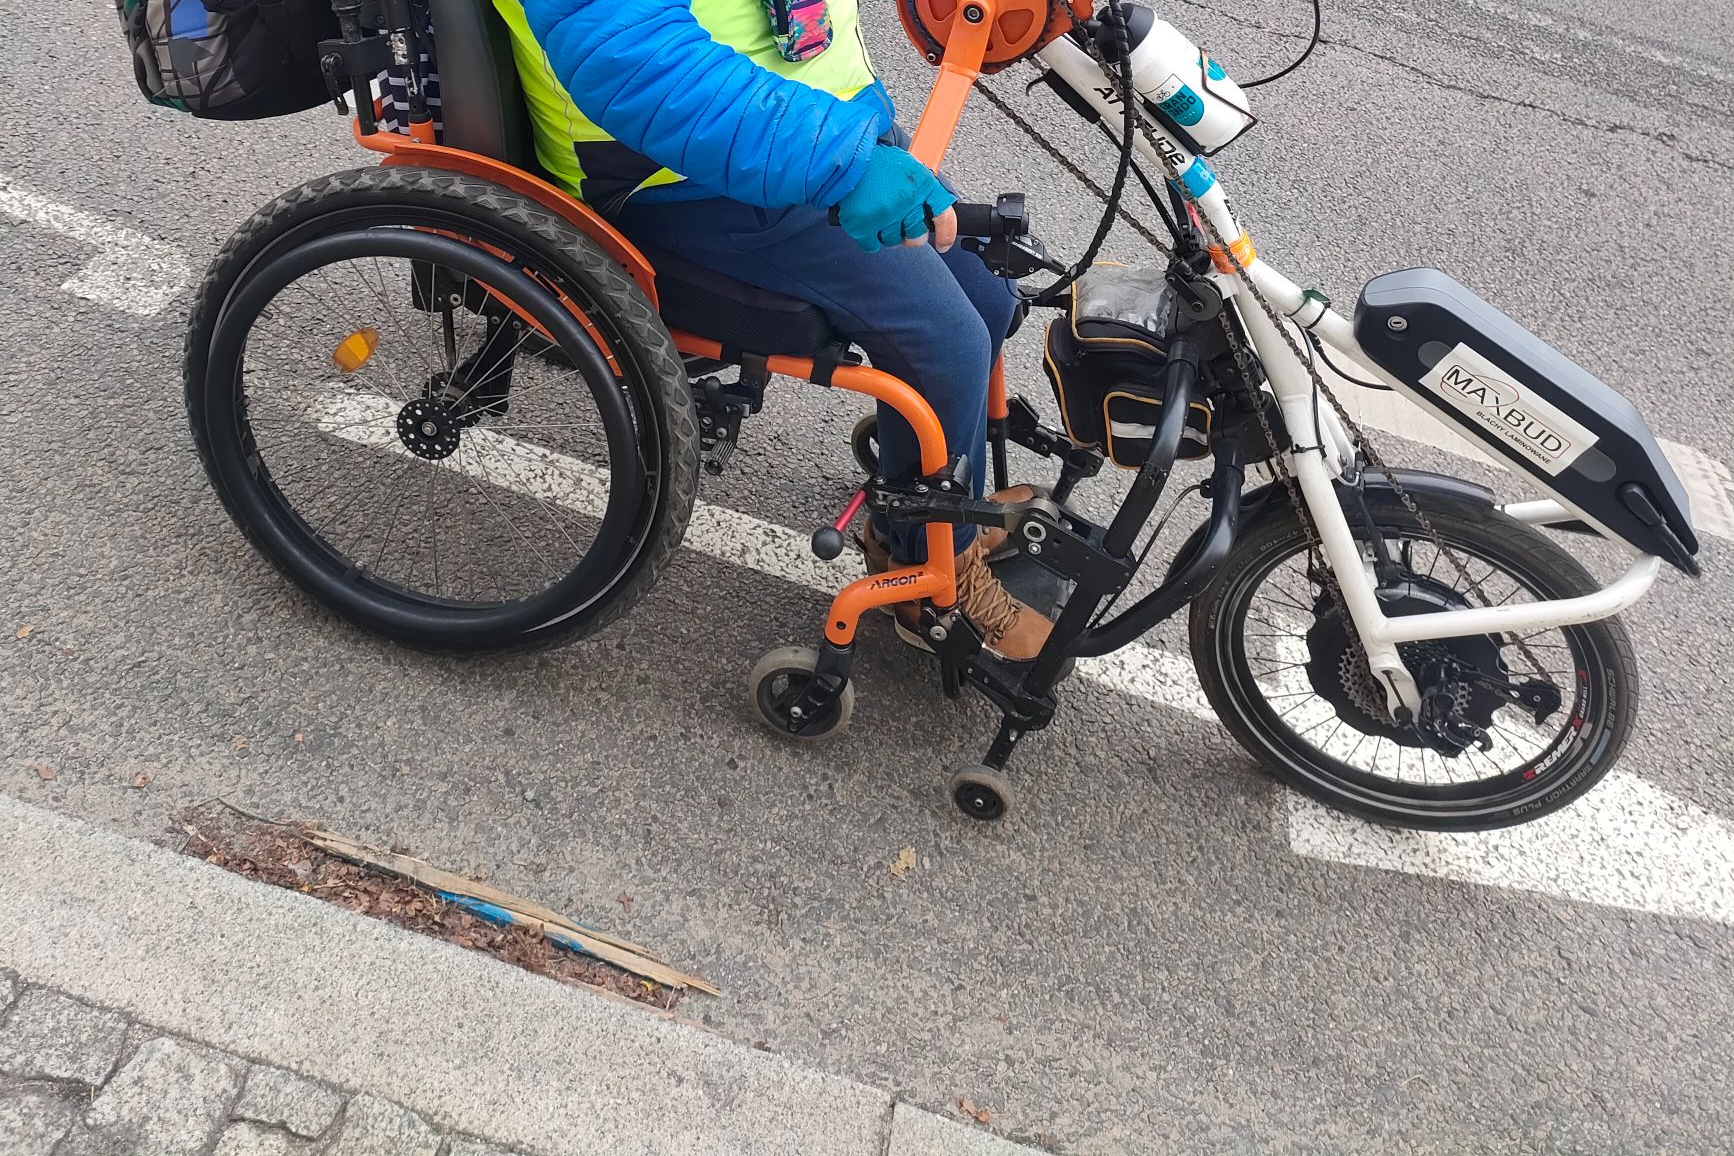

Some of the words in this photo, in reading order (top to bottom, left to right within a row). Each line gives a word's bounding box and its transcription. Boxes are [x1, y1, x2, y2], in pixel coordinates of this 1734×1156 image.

[1165, 95, 1197, 118] ONDO
[1446, 368, 1562, 453] MAXBUD
[1475, 410, 1505, 433] BLACHY
[1504, 429, 1552, 465] LAMINOWANE
[1605, 667, 1617, 730] SCHWALBE
[1545, 763, 1593, 803] MARATHON
[1511, 801, 1542, 816] PLUS
